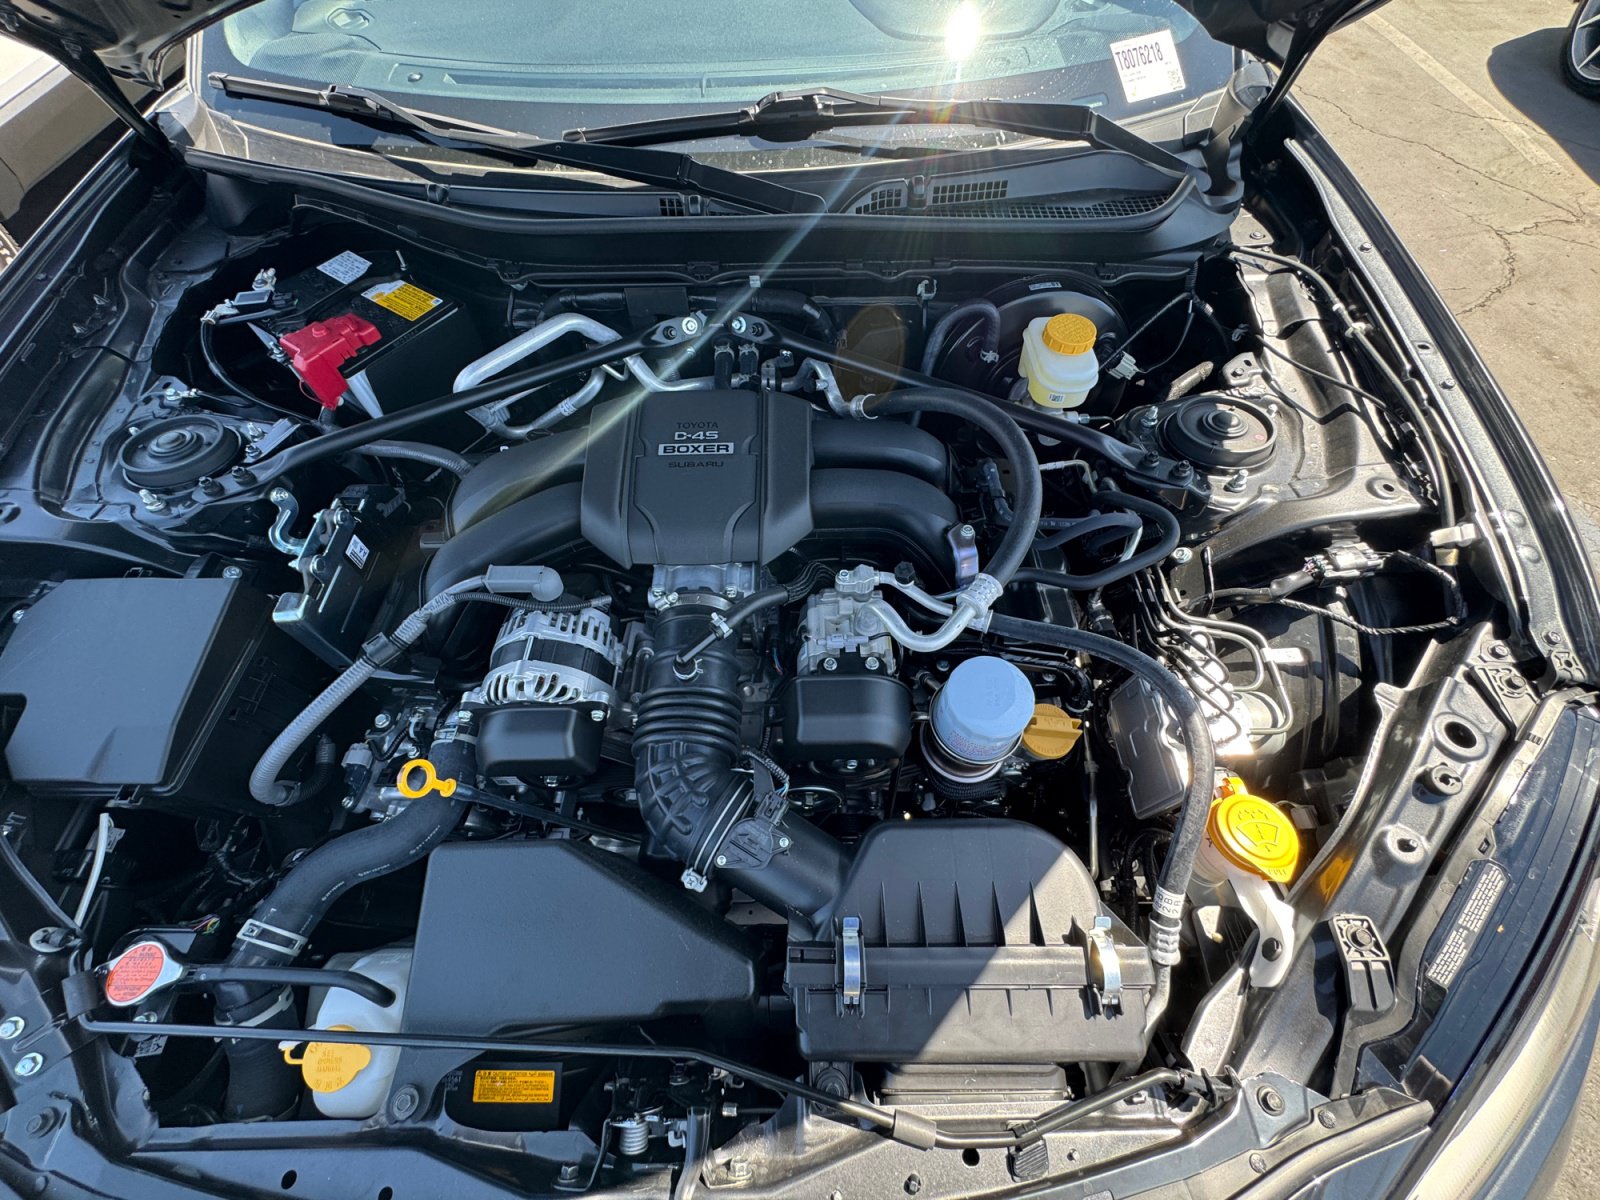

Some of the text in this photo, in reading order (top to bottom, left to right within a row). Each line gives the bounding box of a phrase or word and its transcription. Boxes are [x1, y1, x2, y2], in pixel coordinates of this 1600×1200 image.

[1115, 41, 1163, 71] T8076218
[676, 421, 719, 429] TOYOTA
[662, 444, 730, 454] BOXER
